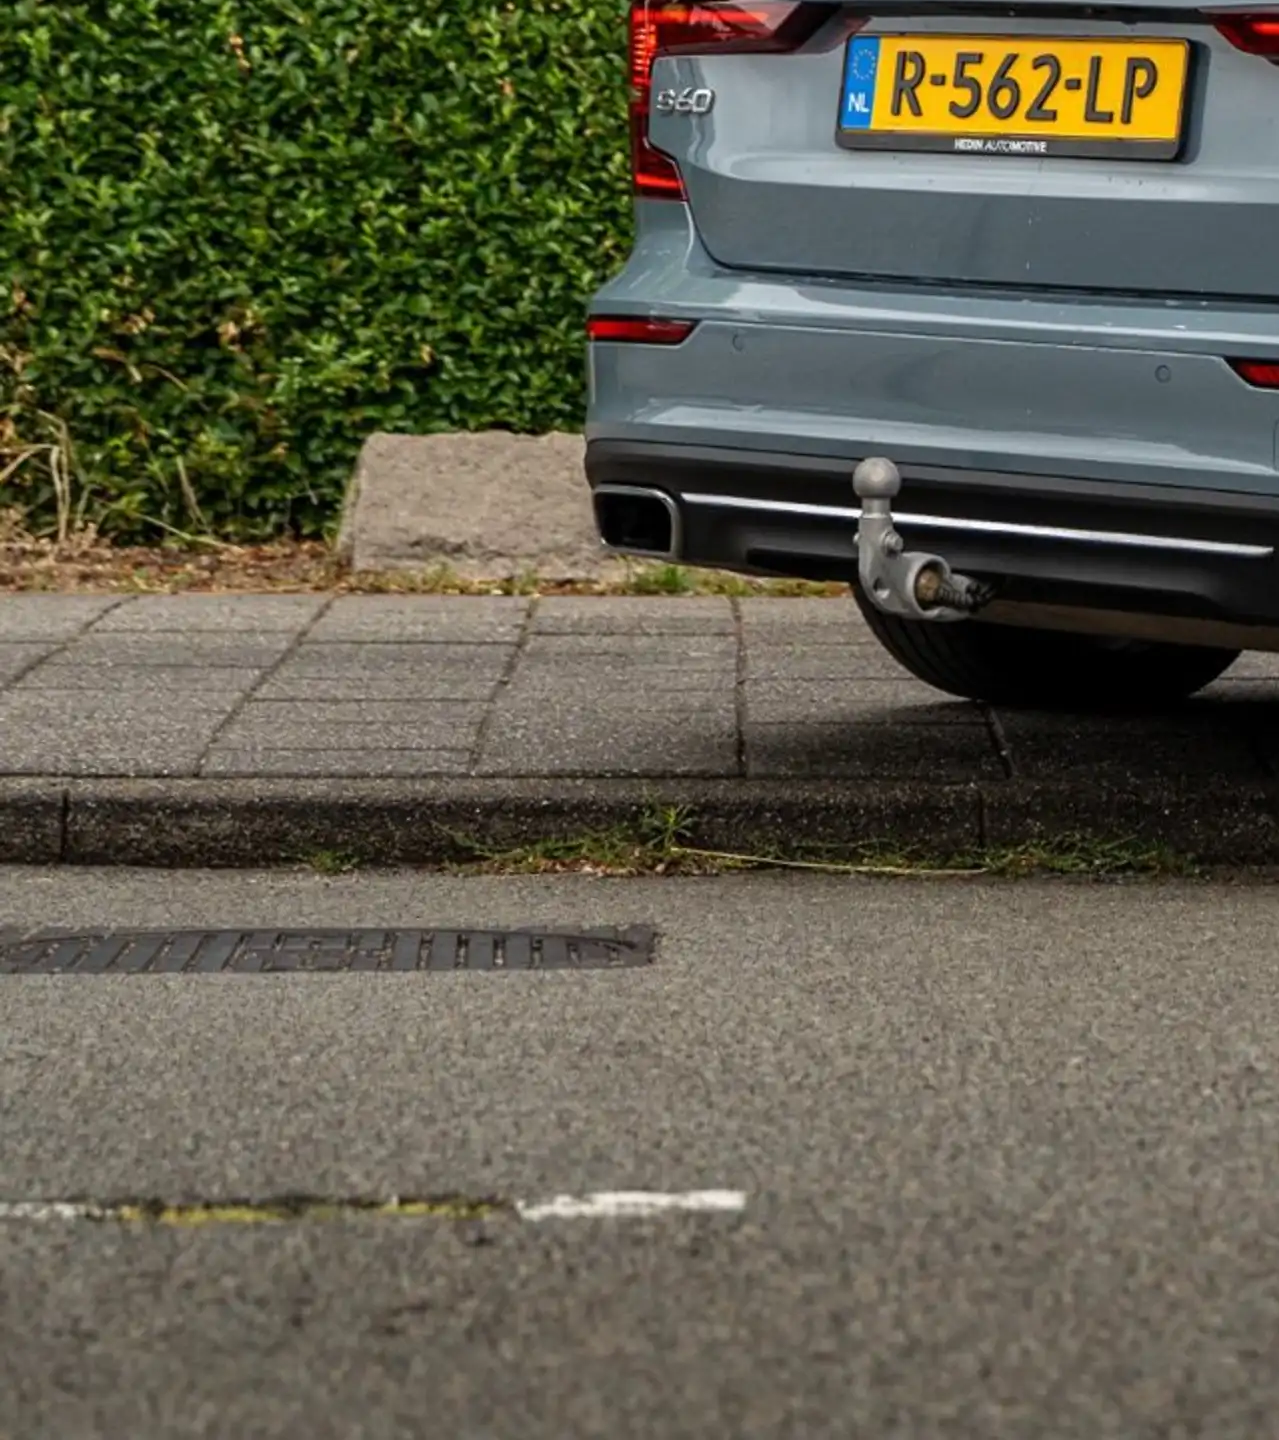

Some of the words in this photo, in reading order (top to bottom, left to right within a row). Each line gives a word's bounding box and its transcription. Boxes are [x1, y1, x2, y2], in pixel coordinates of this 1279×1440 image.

[656, 87, 713, 113] S60
[890, 50, 1158, 125] R-562-LP
[848, 91, 870, 112] NL
